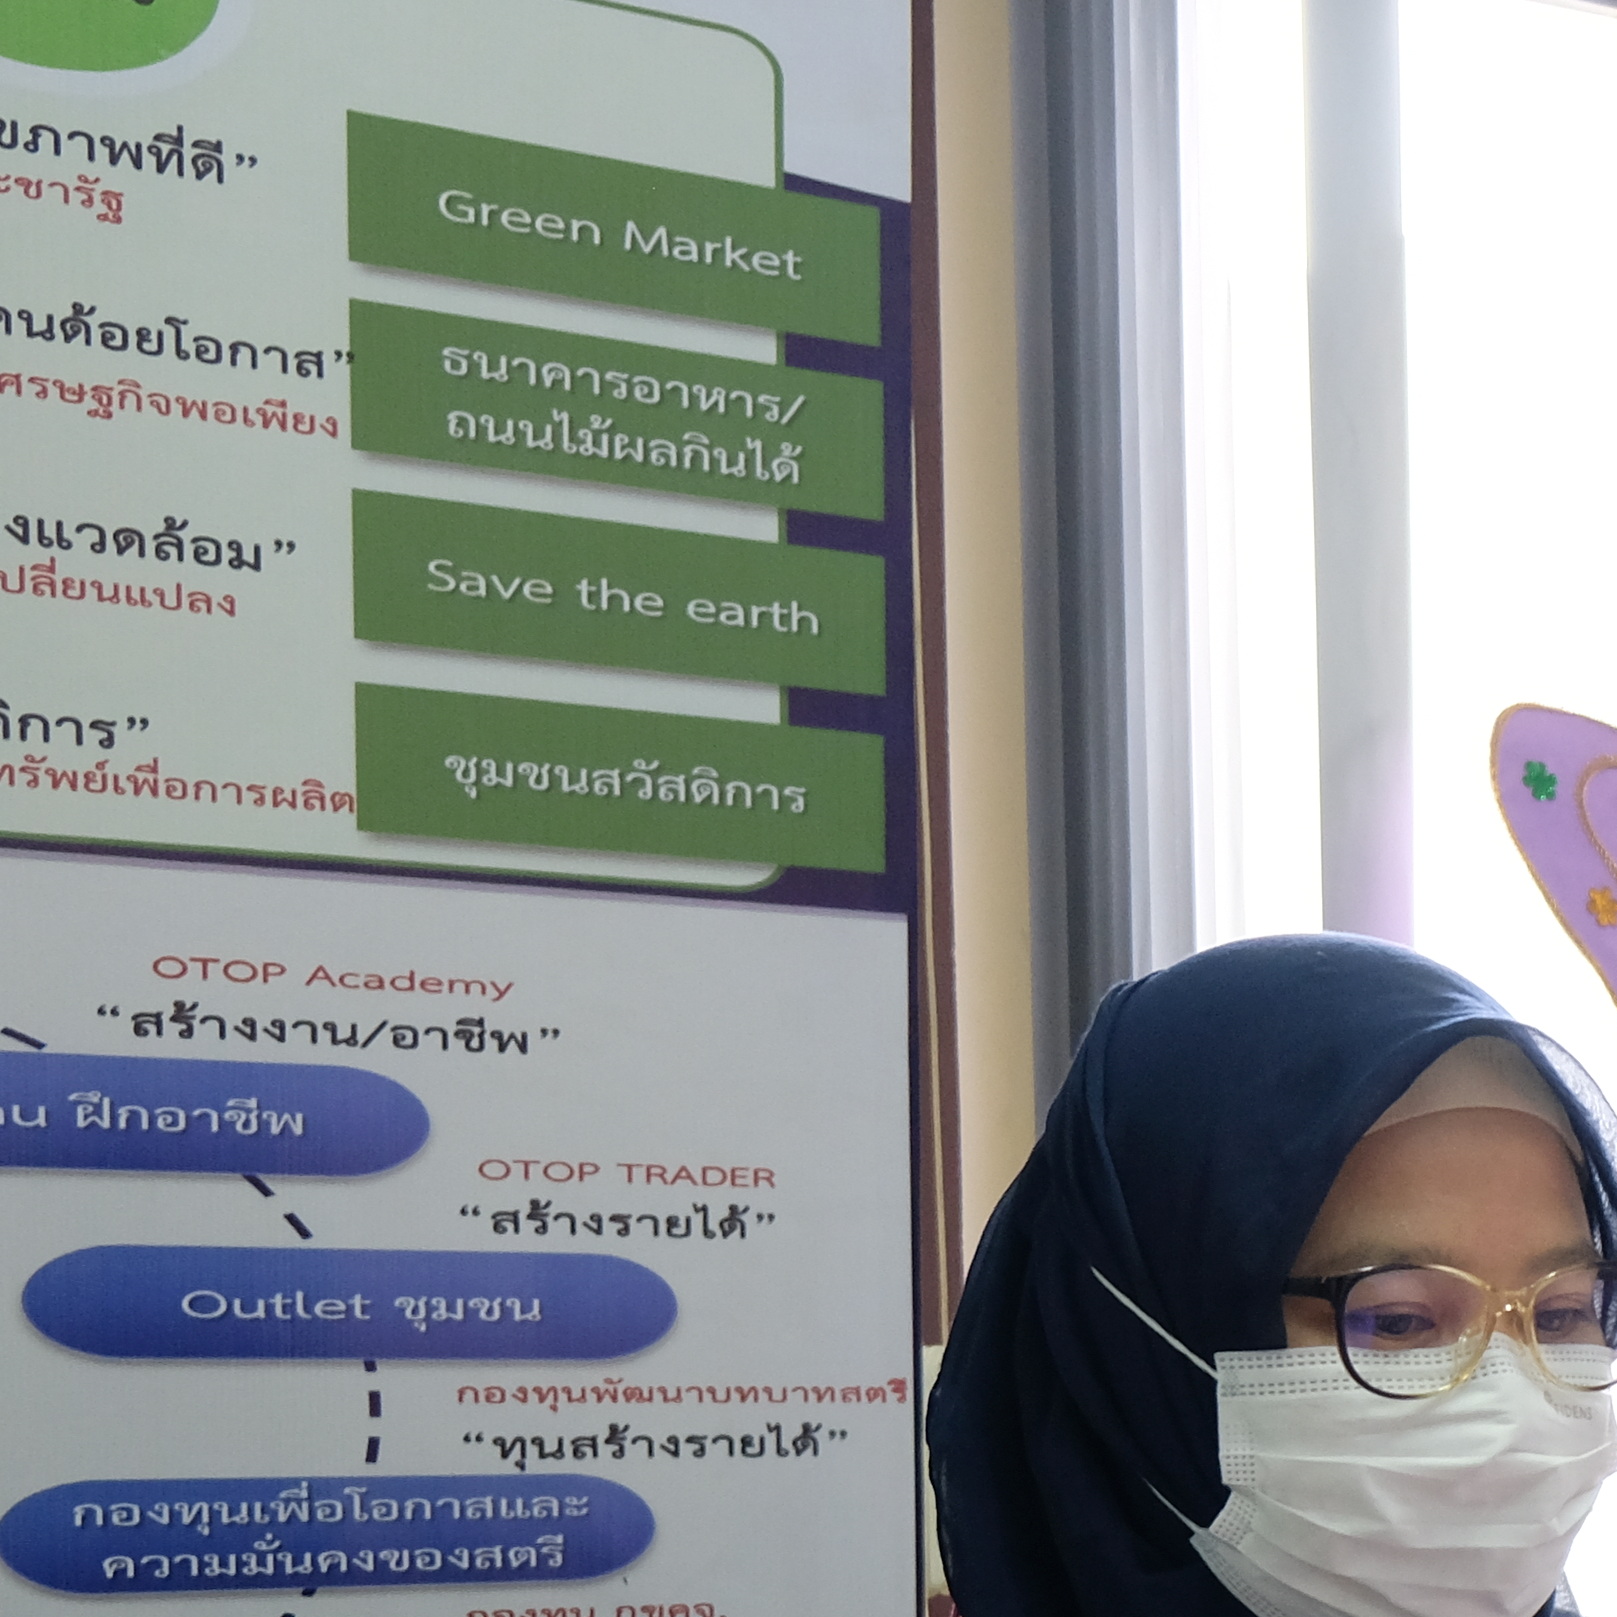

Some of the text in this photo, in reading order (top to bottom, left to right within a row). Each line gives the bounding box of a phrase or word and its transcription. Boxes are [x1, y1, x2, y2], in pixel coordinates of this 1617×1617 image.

[438, 189, 803, 281] Green Market
[442, 345, 806, 425] ธนาคารอาหาร/
[446, 408, 804, 484] ถนนไม้ผลกินได้
[426, 559, 820, 635] Save the earth
[444, 754, 808, 813] ชุมชนสวัสดิการ
[152, 956, 515, 1002] OTOP Academy
[67, 1090, 305, 1136] ฝึกอาชีพ
[478, 1159, 776, 1189] OTOP TRADER
[181, 1289, 542, 1333] Outlet ชุมชน
[72, 1482, 590, 1536] กองทุนเพื่อโอกาสและ
[102, 1532, 566, 1580] ความมั่นคงของสตรี
